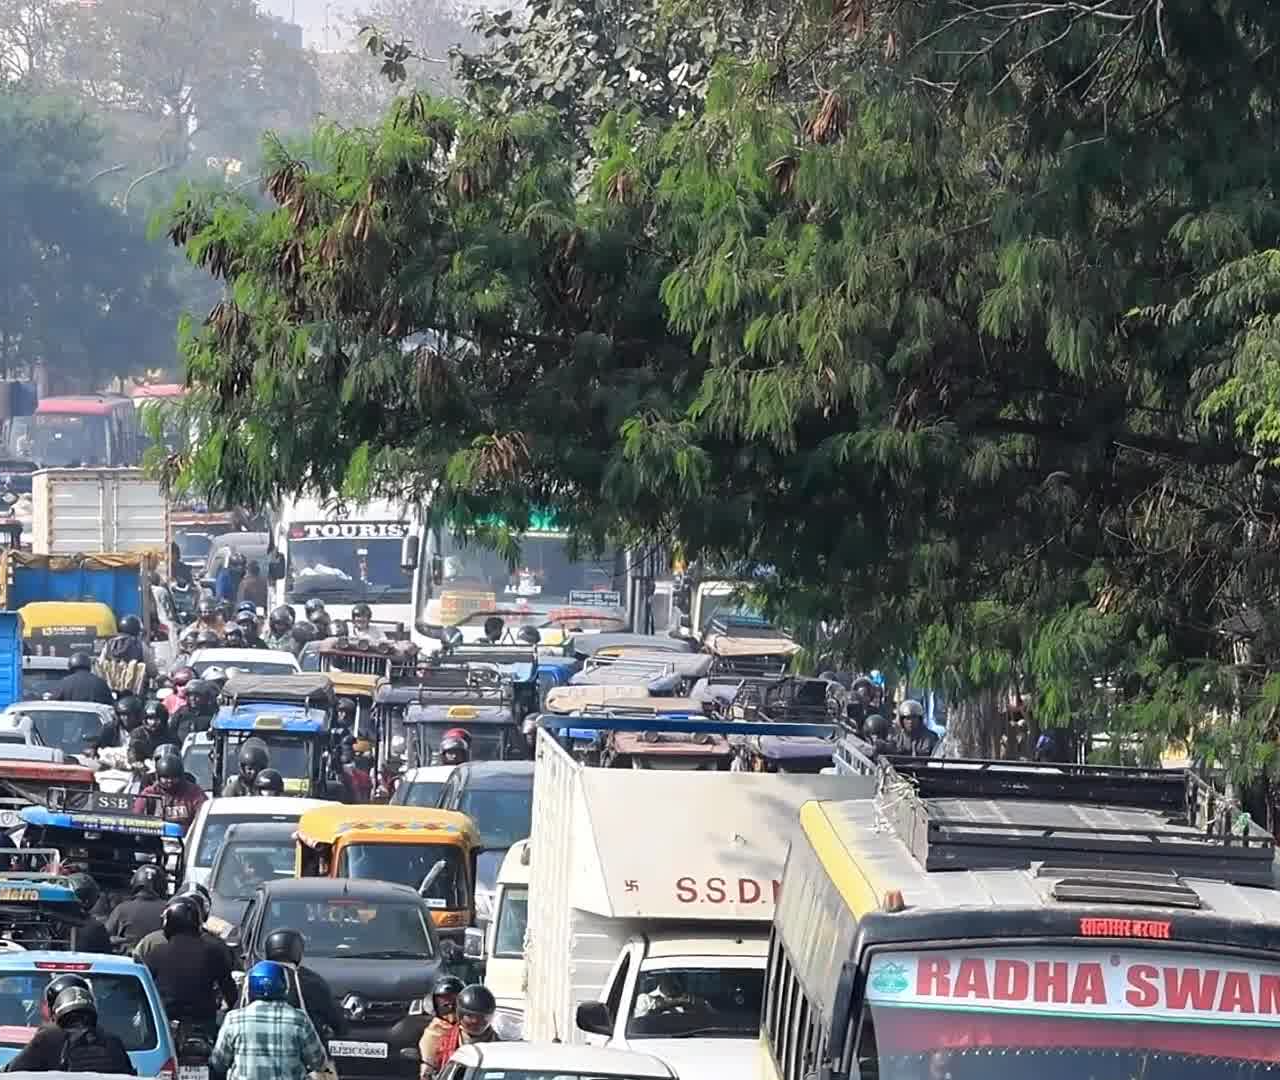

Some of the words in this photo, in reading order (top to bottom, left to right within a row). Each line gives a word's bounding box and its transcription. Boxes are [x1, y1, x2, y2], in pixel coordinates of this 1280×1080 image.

[304, 524, 412, 538] TOURIST
[97, 796, 129, 810] SSB
[0, 887, 39, 901] Metro
[915, 959, 1107, 1005] RADHA
